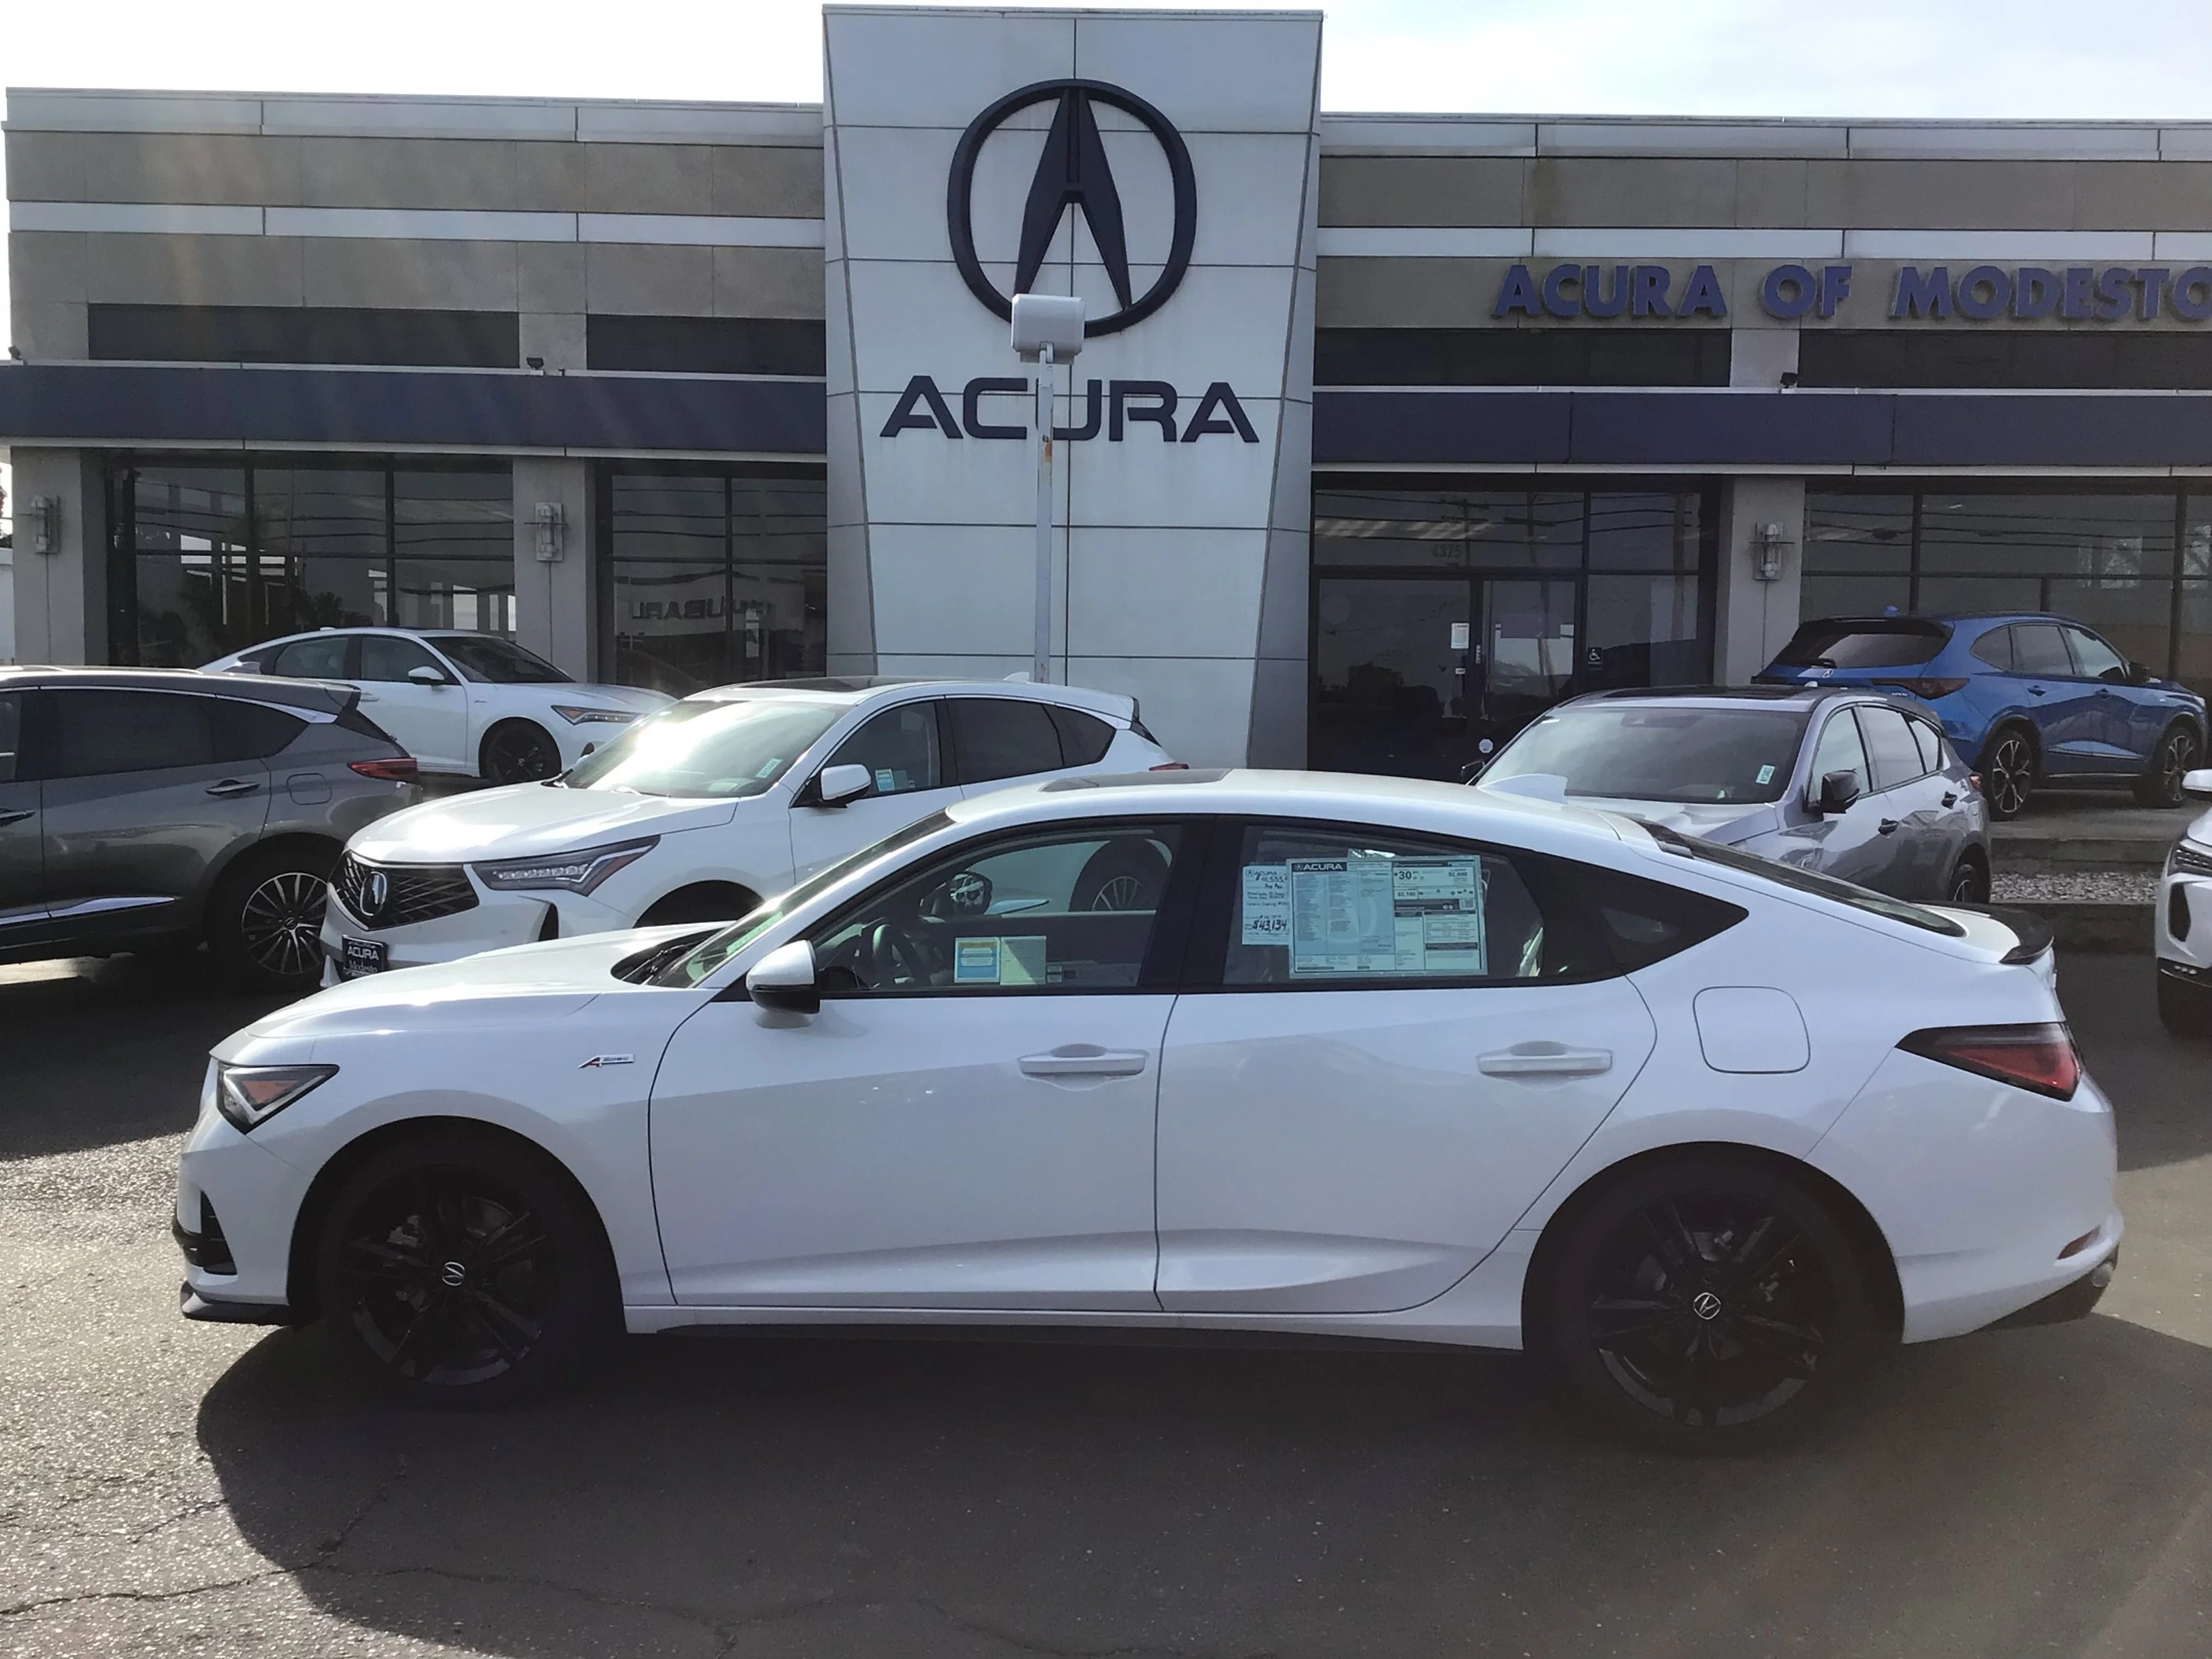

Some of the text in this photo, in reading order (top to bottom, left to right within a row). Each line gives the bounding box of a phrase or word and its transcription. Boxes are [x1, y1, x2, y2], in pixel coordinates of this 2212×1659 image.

[1492, 264, 2212, 322] ACURA OF MODESTO
[879, 375, 1260, 443] ACURA
[1399, 871, 1412, 880] 30
[347, 945, 379, 961] ACURA
[348, 959, 378, 974] Modesto
